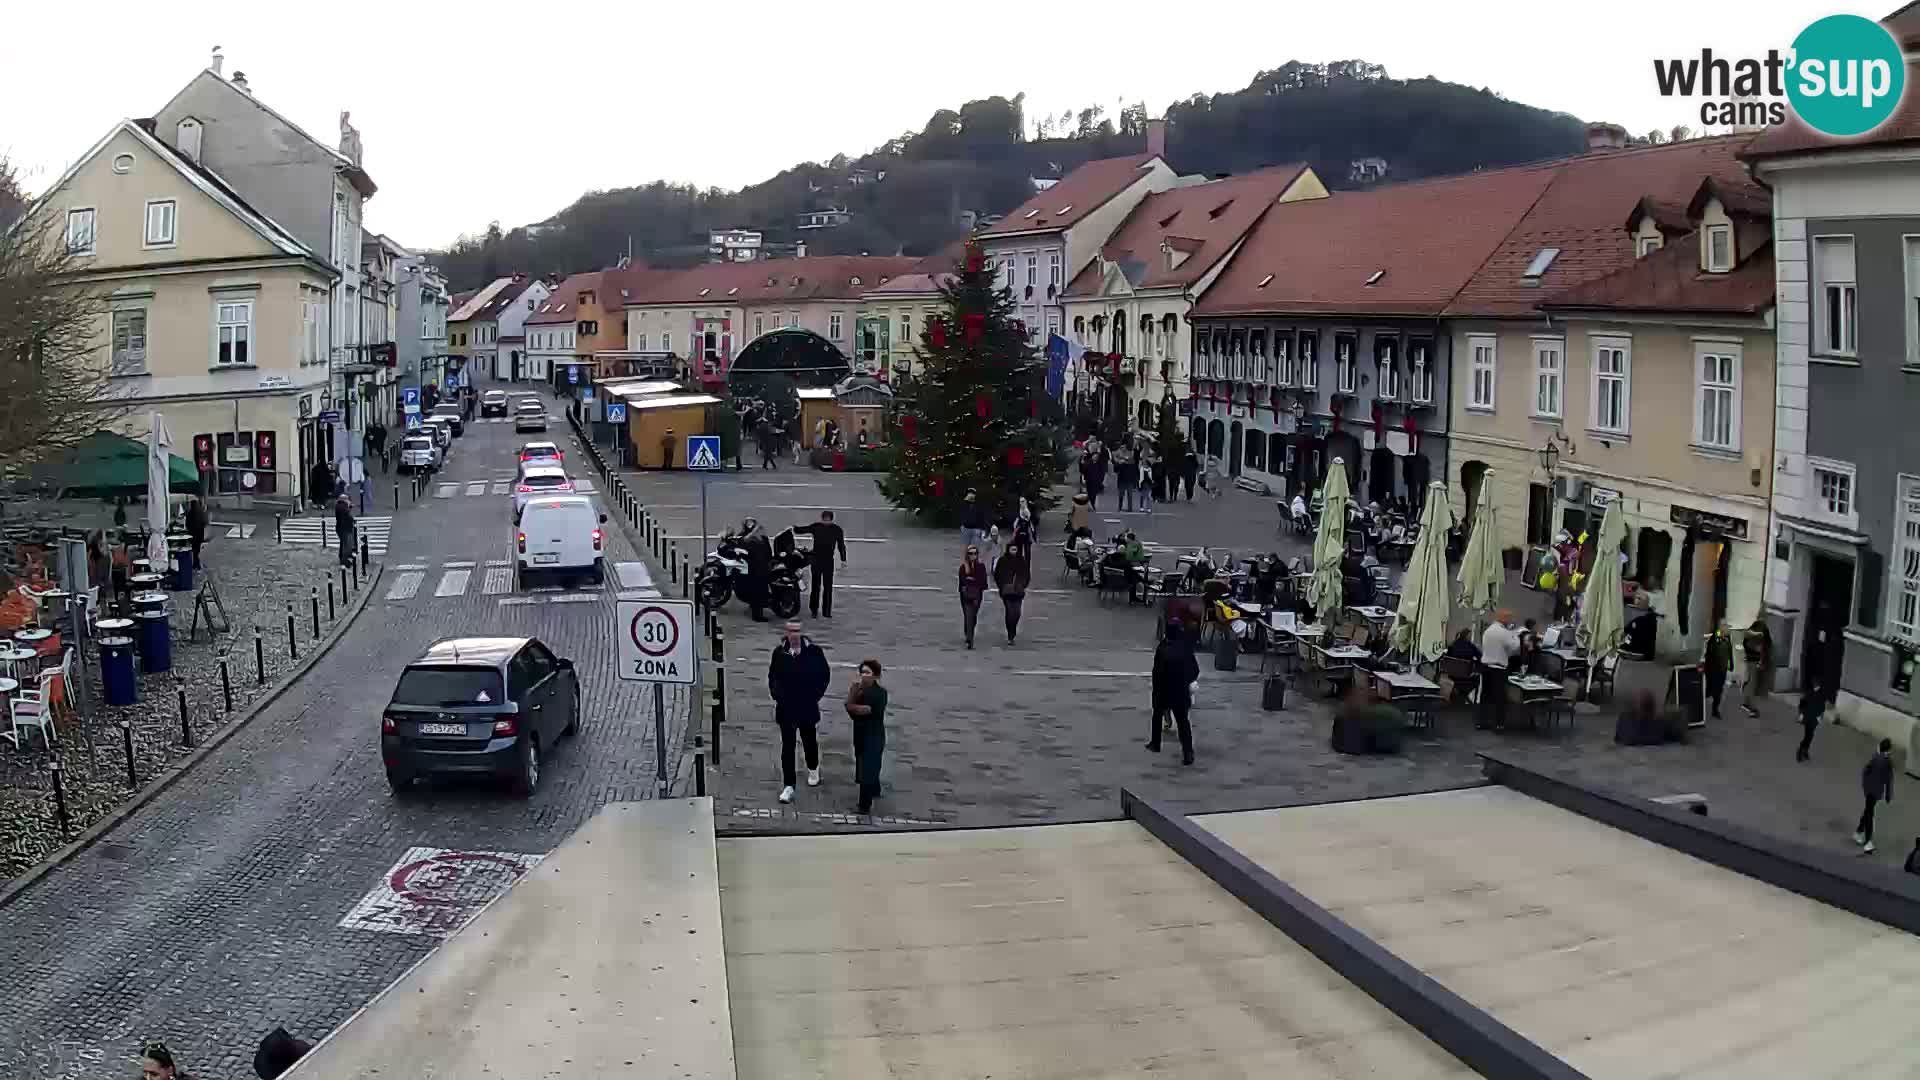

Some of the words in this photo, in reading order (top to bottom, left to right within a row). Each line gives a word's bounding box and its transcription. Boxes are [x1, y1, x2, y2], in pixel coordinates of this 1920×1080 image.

[407, 392, 416, 402] P
[643, 622, 667, 643] 30
[634, 660, 678, 676] ZONA
